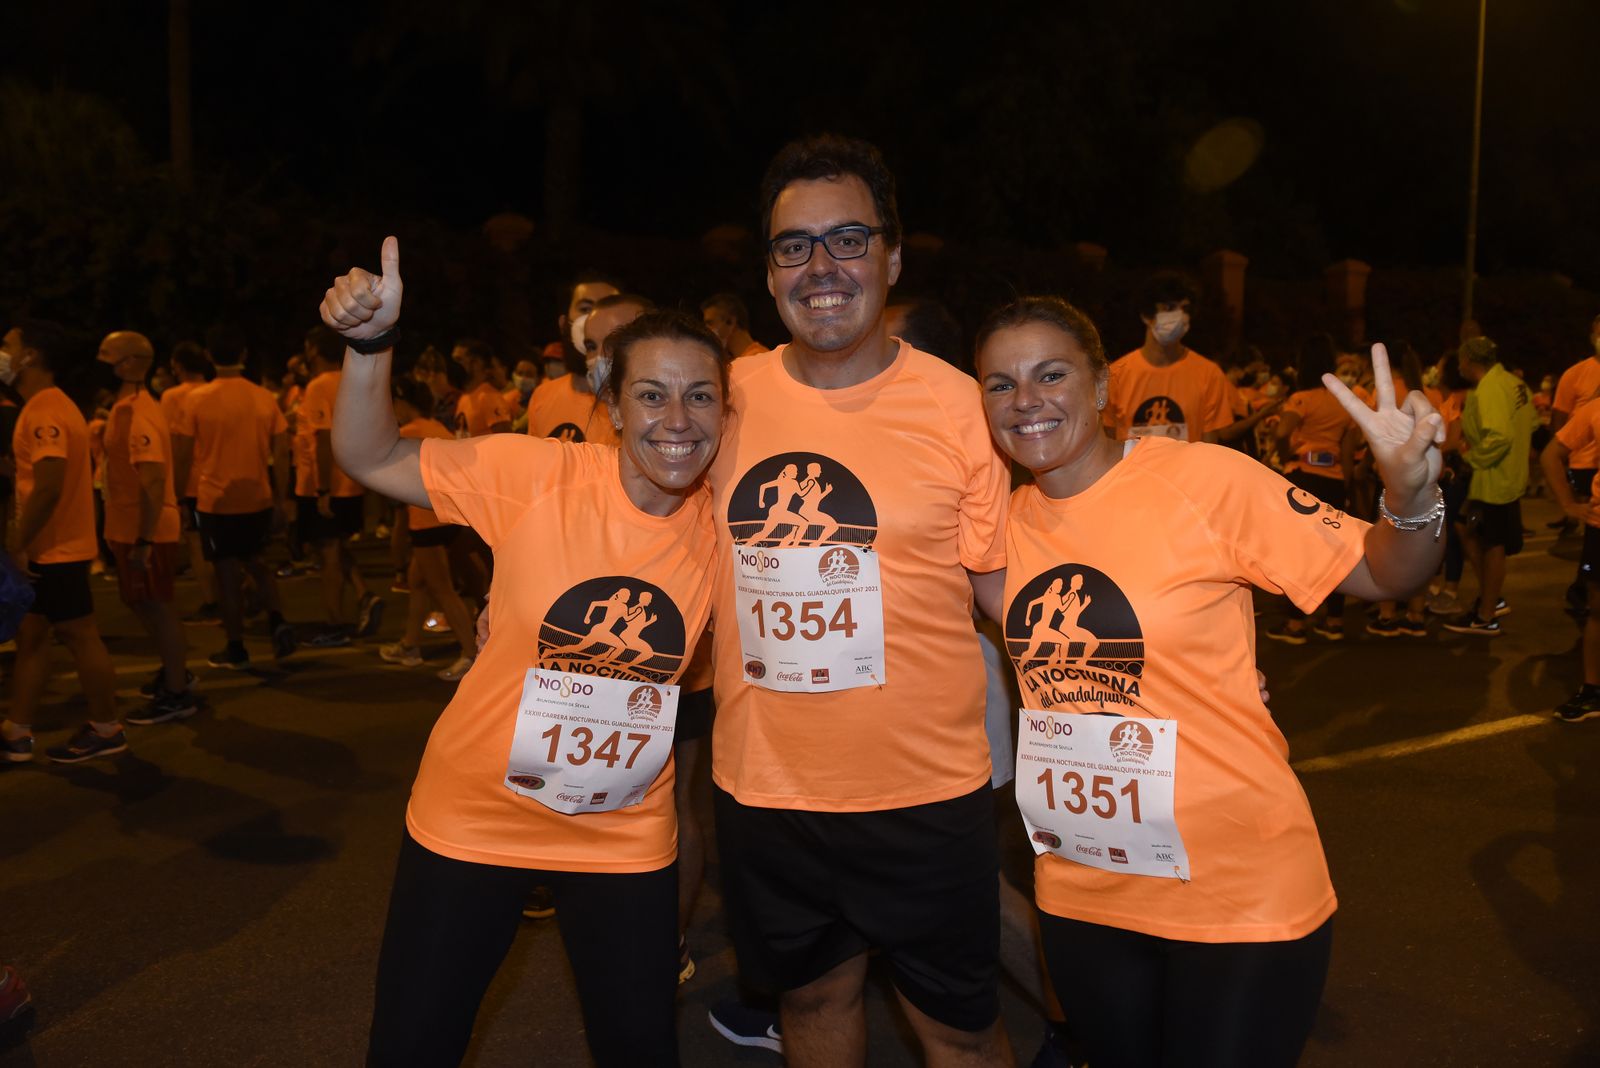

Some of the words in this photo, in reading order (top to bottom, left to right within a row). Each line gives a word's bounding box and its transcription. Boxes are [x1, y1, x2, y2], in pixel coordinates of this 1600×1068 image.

[829, 573, 858, 581] NOCTURNA
[806, 587, 851, 597] GUADALQUIVIR
[751, 597, 858, 641] 1354
[856, 664, 873, 673] ABC
[1025, 674, 1041, 693] LA
[1038, 667, 1141, 697] NOCTURNA
[541, 711, 568, 721] CARRERA
[569, 715, 600, 724] NOCTURNA
[611, 720, 651, 730] GUADALQUIVIR
[541, 723, 652, 770] 1347
[1119, 750, 1151, 761] NOCTURNA
[1034, 755, 1056, 764] CARRERA
[1056, 759, 1086, 768] NOCTURNA
[1097, 763, 1142, 775] GUADALQUIVIR
[1036, 767, 1142, 824] 1351
[1155, 852, 1175, 861] ABC
